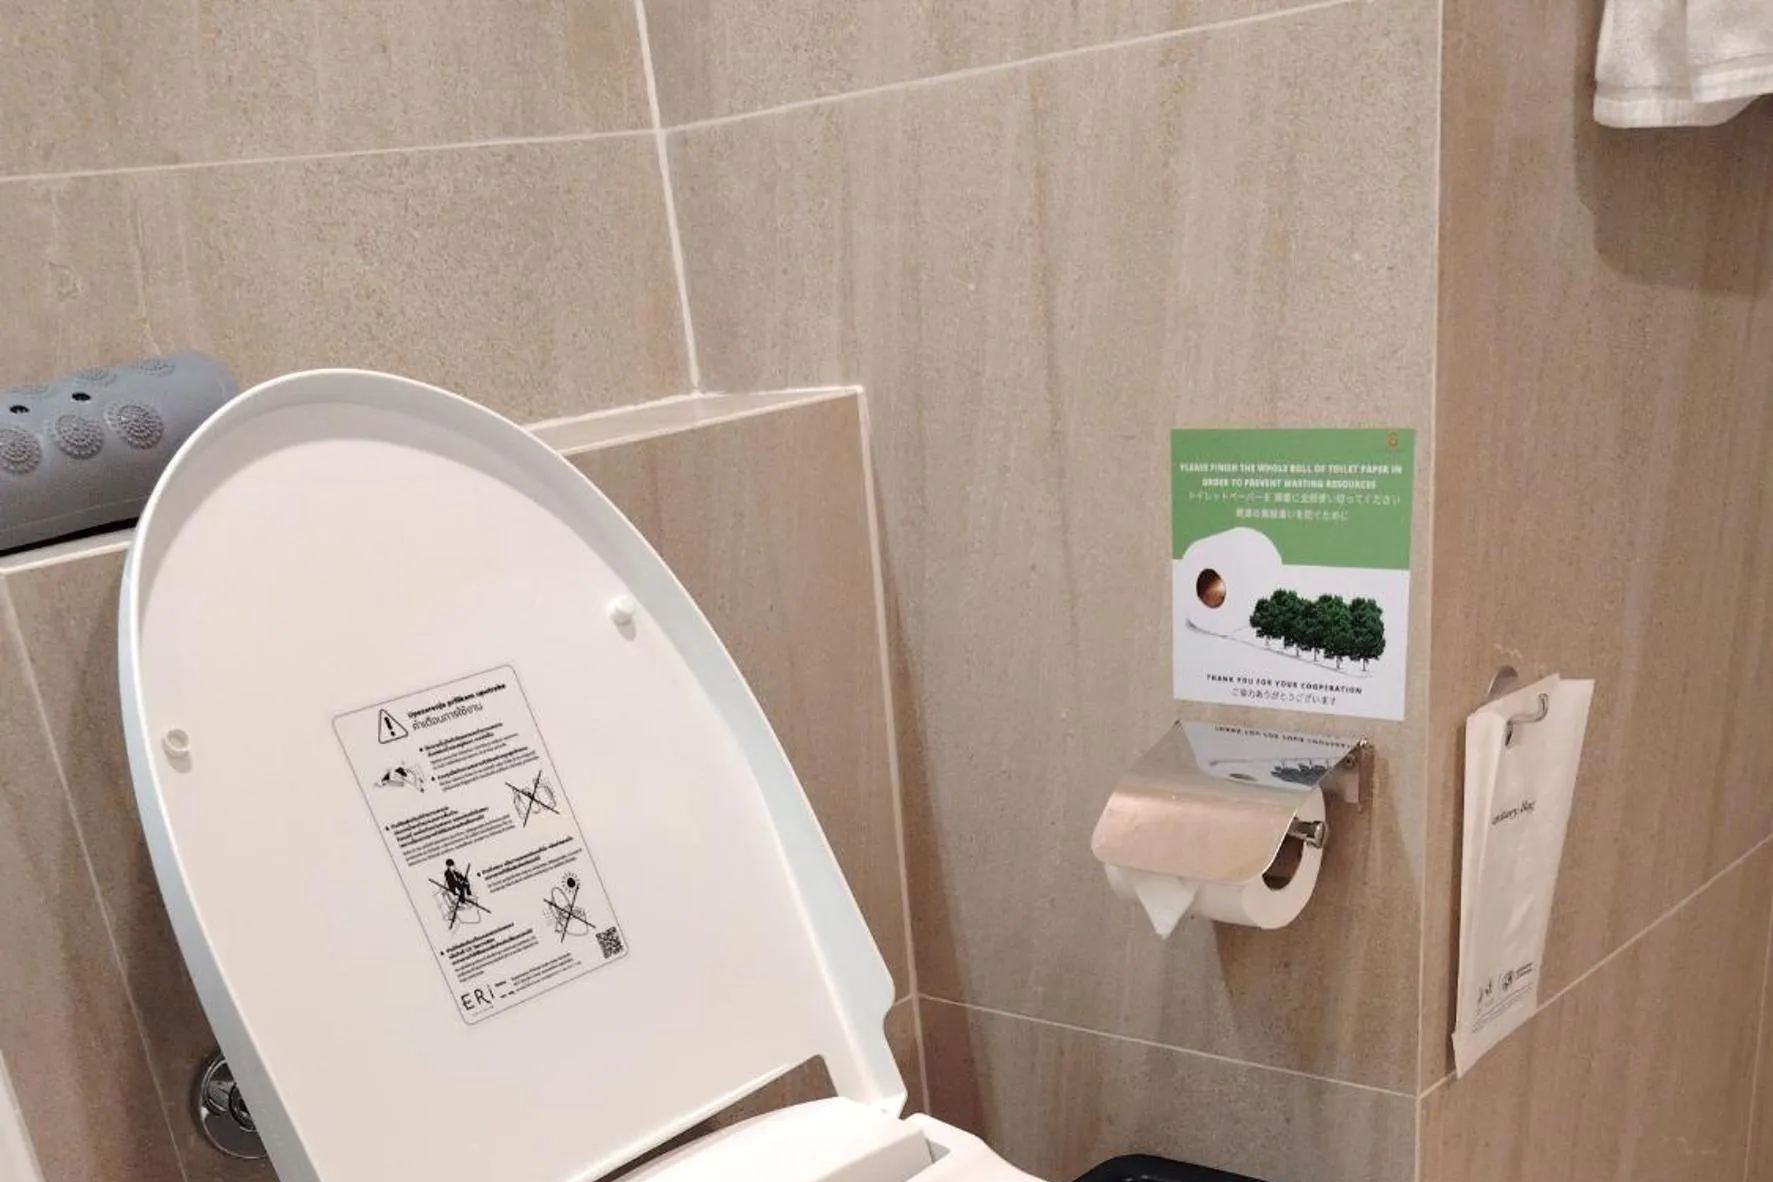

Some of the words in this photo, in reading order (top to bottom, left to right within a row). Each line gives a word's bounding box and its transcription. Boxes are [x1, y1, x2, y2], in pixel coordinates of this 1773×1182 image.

[1180, 462, 1208, 473] PLEASE
[1210, 463, 1238, 473] FINISH
[1240, 463, 1255, 473] THE
[1257, 463, 1288, 473] WHOLE
[1290, 463, 1311, 473] ROLL
[1314, 464, 1326, 473] OF
[1328, 464, 1359, 474] TOILET
[1361, 464, 1389, 475] PAPER
[1202, 478, 1228, 487] ORDER
[1231, 479, 1242, 487] TO
[1244, 479, 1281, 488] PREVENT
[1284, 480, 1323, 488] WASTING
[1326, 480, 1376, 490] RESOURCES
[1206, 674, 1234, 683] THANK
[1237, 676, 1254, 685] YOU
[1256, 677, 1272, 686] FOR
[1275, 679, 1298, 689] YOUR
[1300, 682, 1363, 695] COOPERATION
